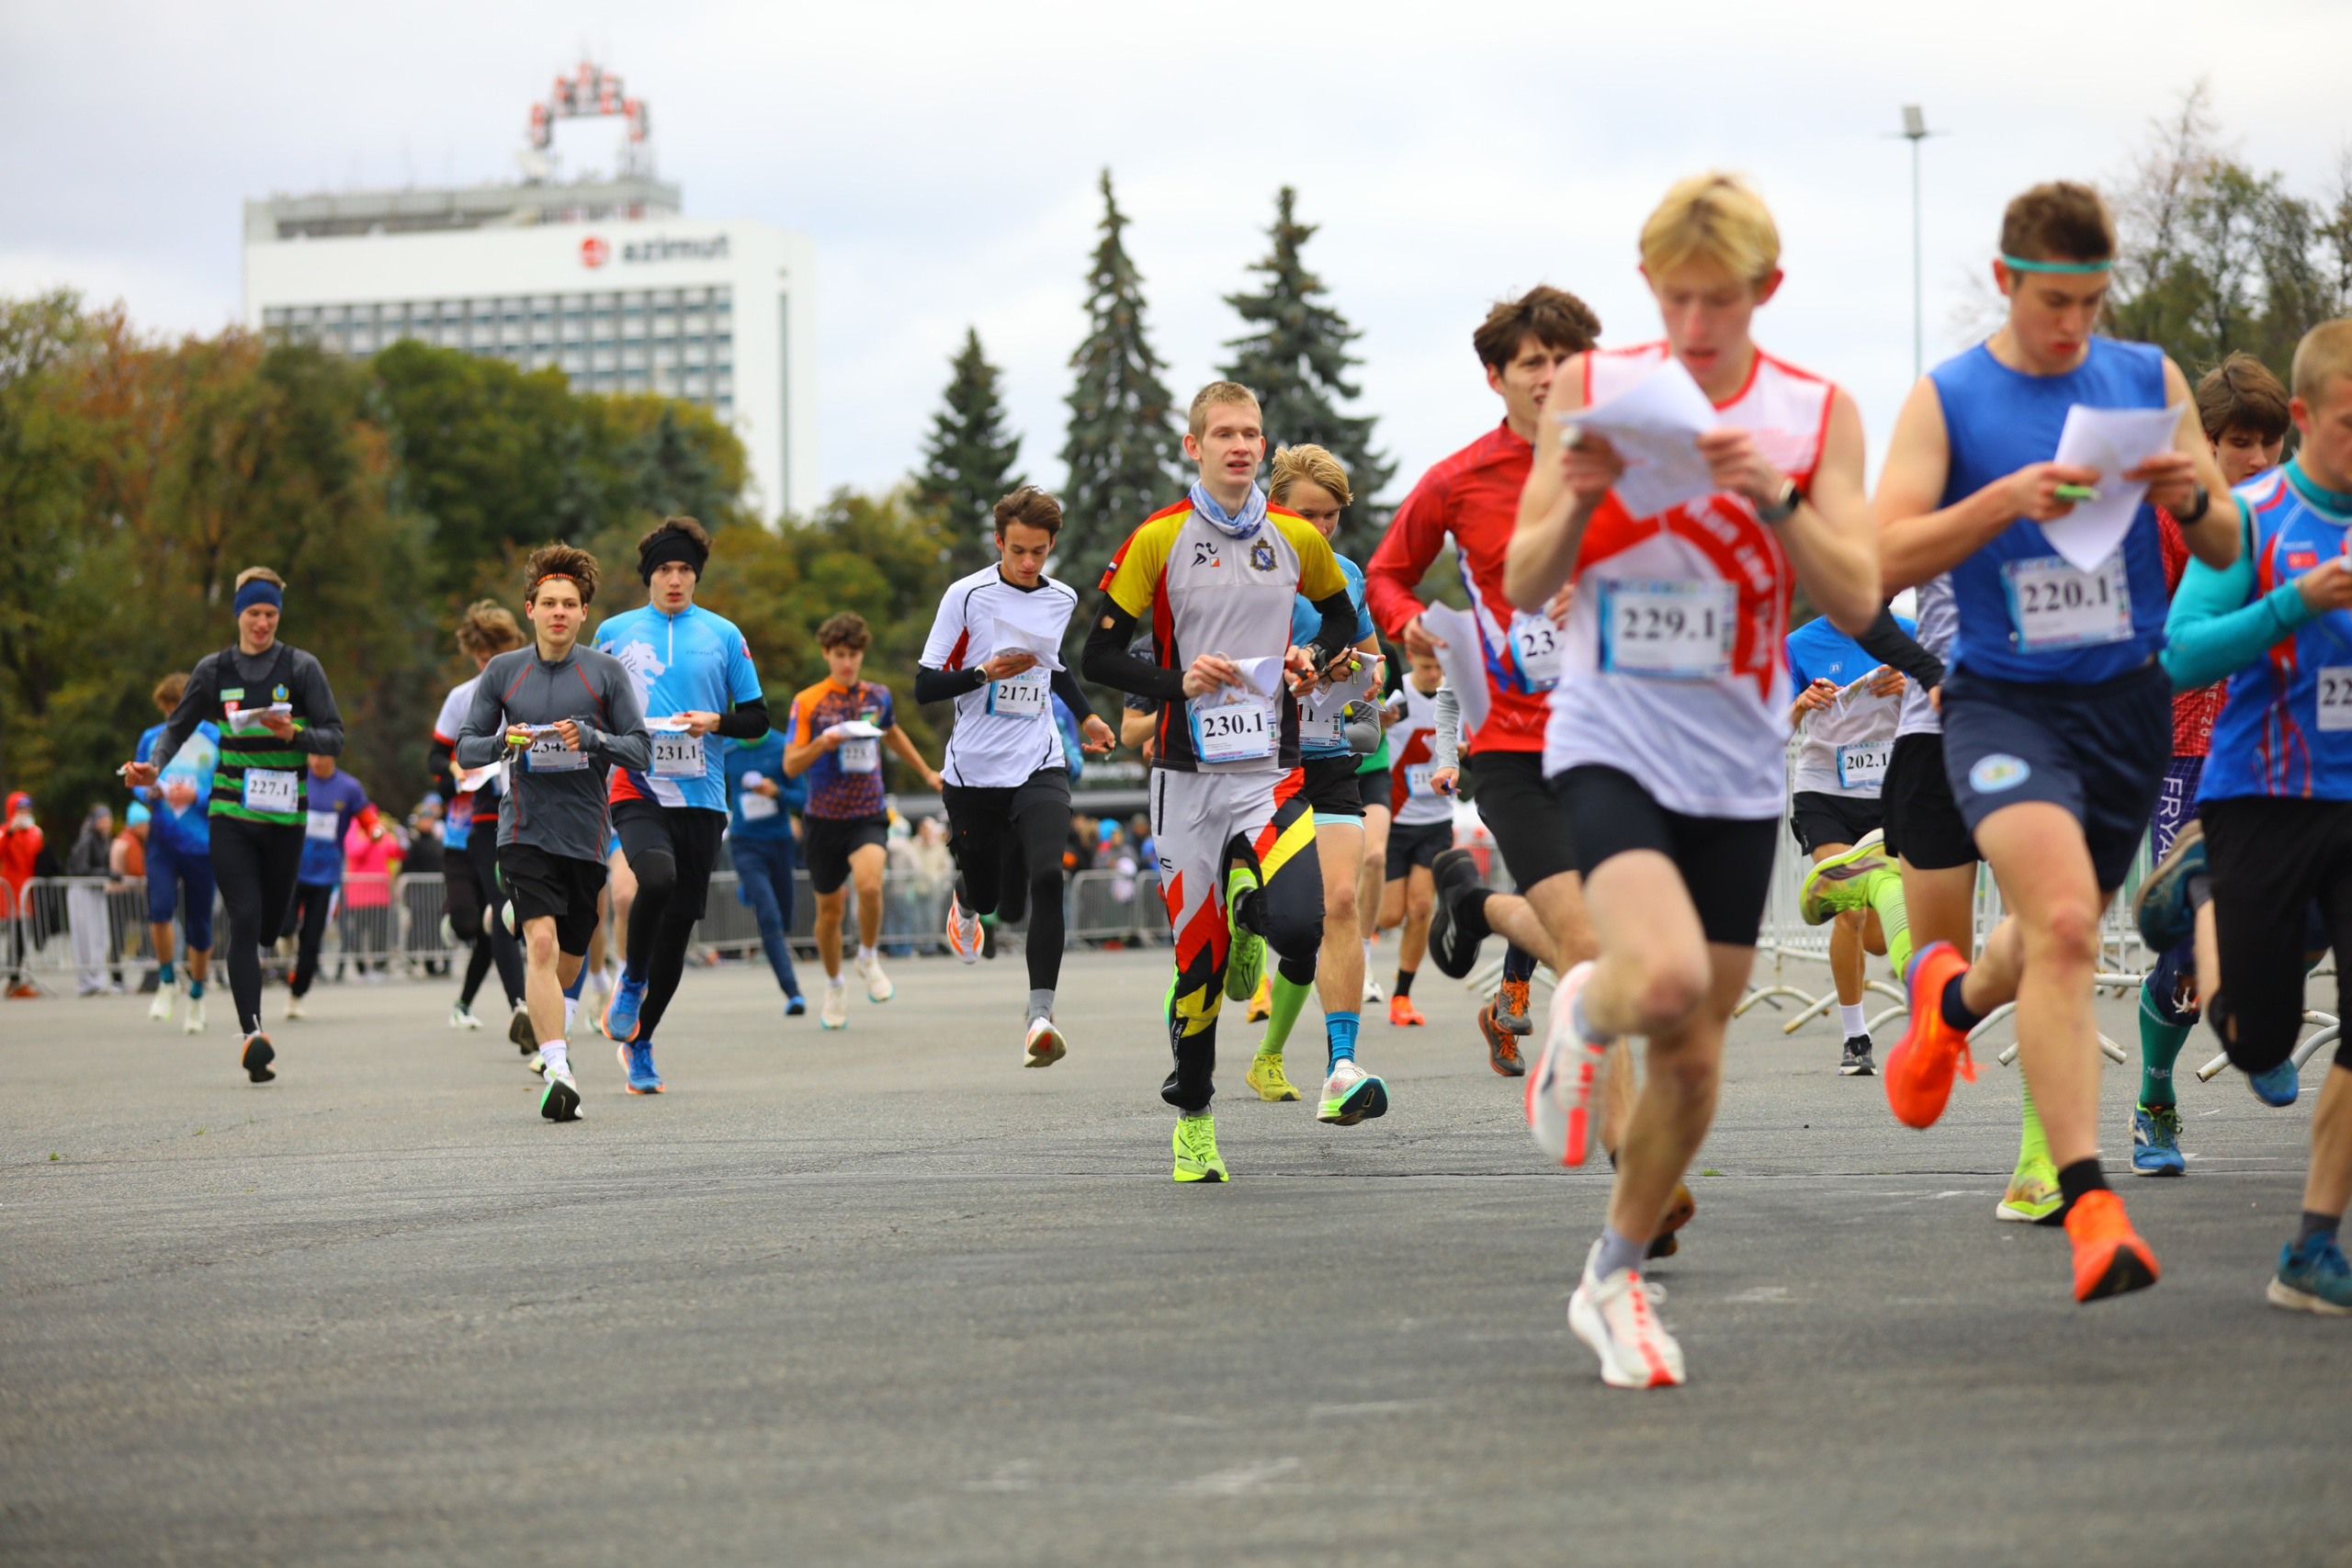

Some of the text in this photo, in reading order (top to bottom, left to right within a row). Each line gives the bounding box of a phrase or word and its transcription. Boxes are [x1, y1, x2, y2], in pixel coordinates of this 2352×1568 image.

[2021, 576, 2109, 615] 220.1
[1621, 606, 1715, 641] 229.1
[998, 684, 1039, 702] 217.1
[1203, 712, 1265, 738] 230.1
[531, 740, 570, 753] 234.
[656, 744, 695, 761] 231.1
[1846, 753, 1888, 770] 202.1
[250, 780, 288, 796] 227.1
